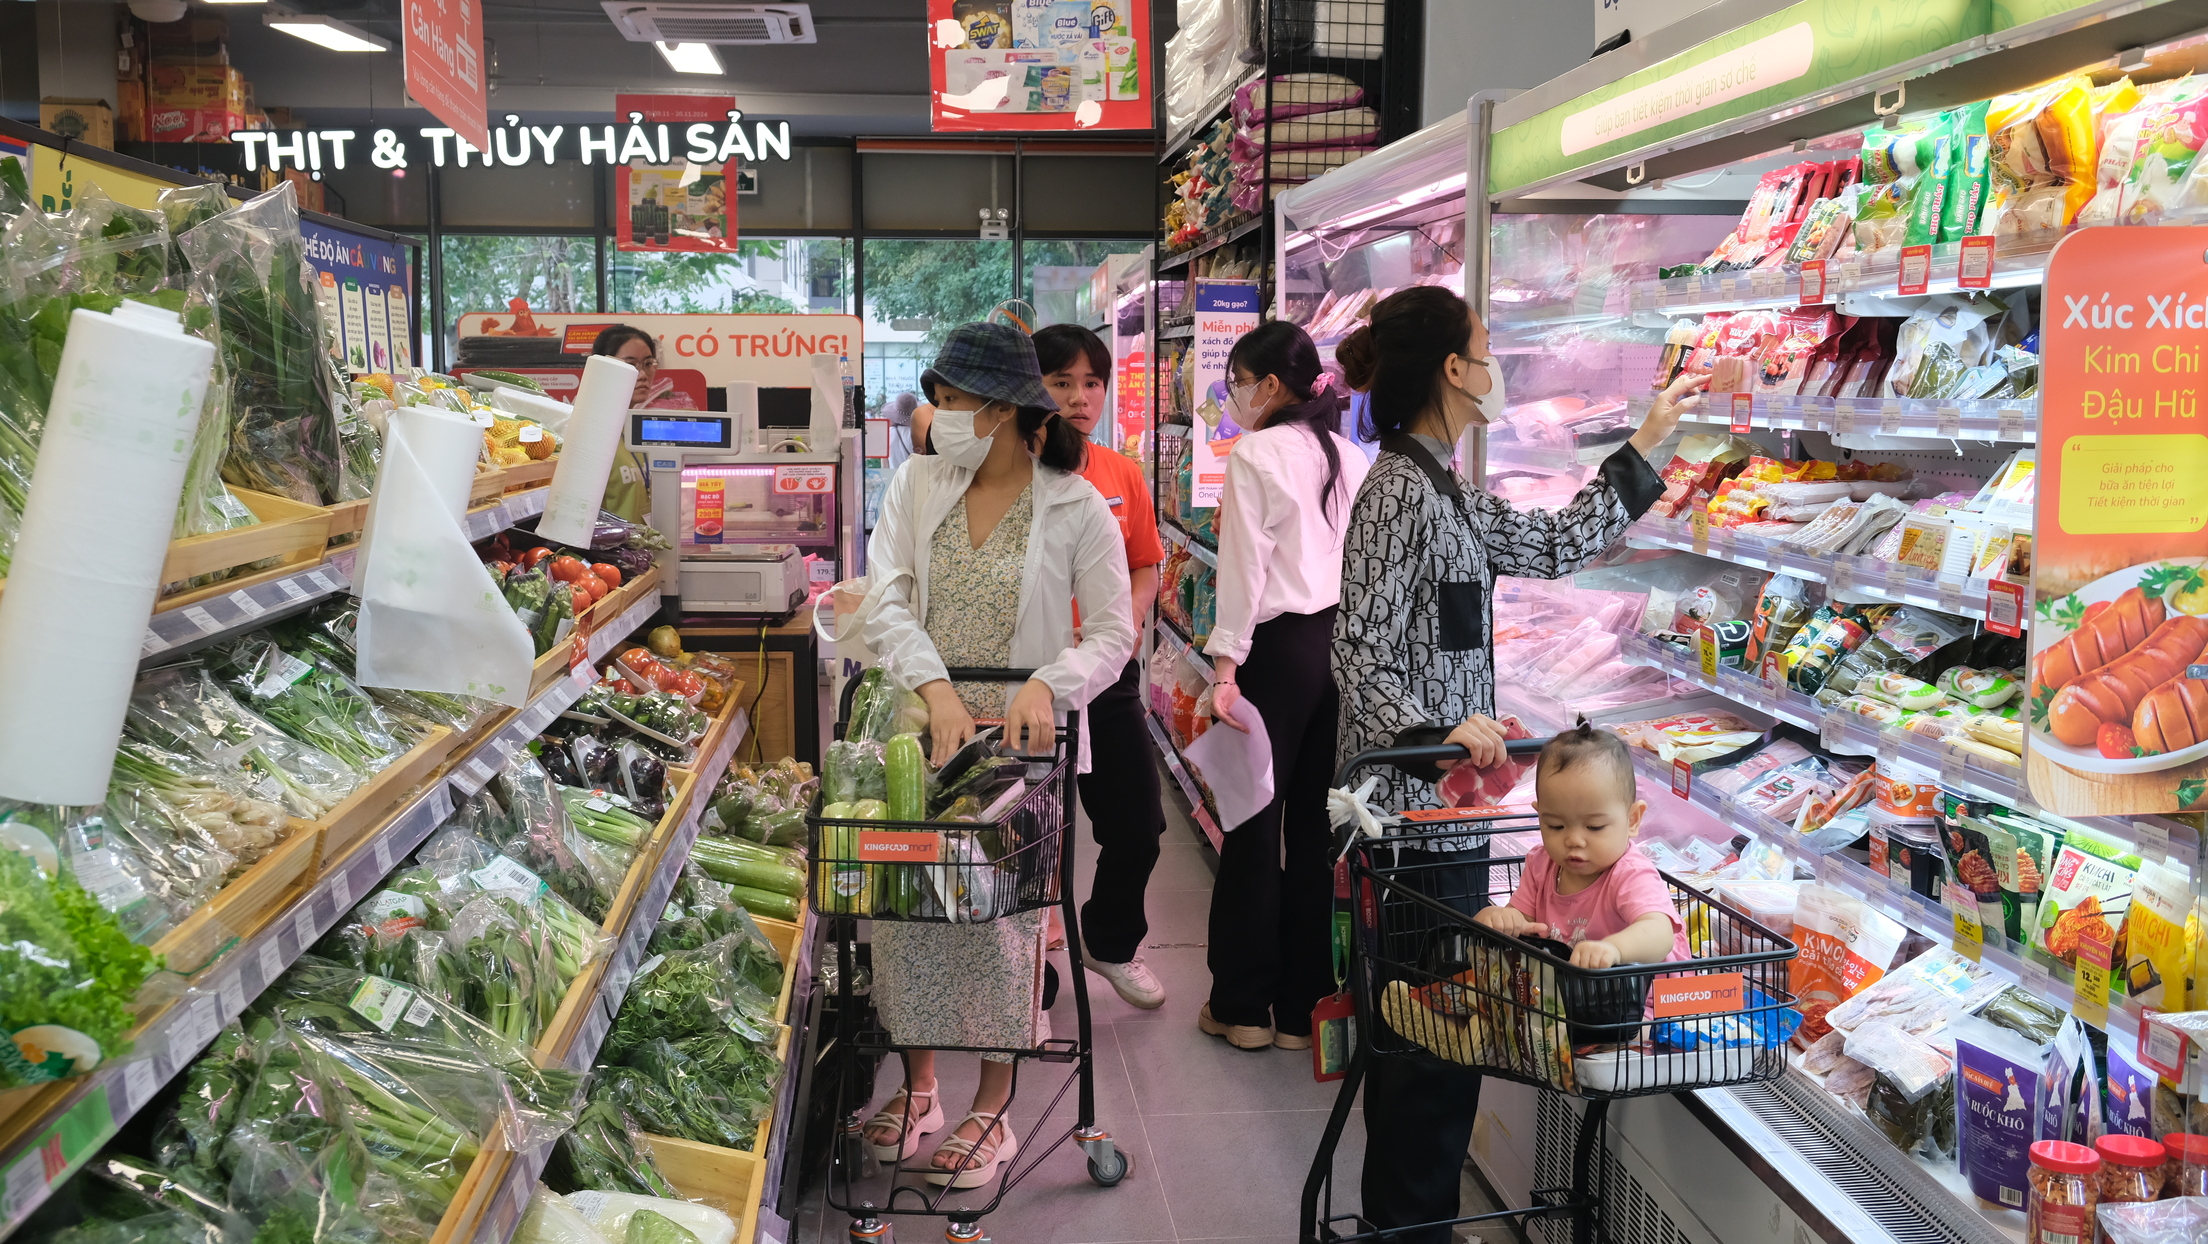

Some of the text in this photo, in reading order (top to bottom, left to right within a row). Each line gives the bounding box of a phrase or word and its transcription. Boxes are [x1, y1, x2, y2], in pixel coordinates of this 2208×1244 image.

[1057, 18, 1077, 27] Blue
[1093, 9, 1113, 27] Gift
[969, 24, 999, 39] SWAT
[431, 20, 455, 78] Hàng
[1594, 52, 1757, 137] Giúp bạn tiết kiệm thời gian sơ chế
[231, 110, 791, 181] THỊT & THỦY HẢI SẢN
[1929, 183, 1945, 236] THỌ PHÁT
[1964, 181, 1981, 234] THỌ PHÁT
[320, 238, 335, 266] ĐỘ
[336, 240, 350, 266] ĂN
[1212, 299, 1248, 310] 20kg gạo?
[2062, 291, 2134, 330] Xúc
[1202, 319, 1256, 335] Miễn phí
[675, 326, 849, 358] CÓ TRỨNG!
[1202, 336, 1221, 345] xách
[1201, 348, 1220, 358] giúp
[2084, 344, 2201, 374] Kim Chi
[2081, 388, 2197, 426] Đậu Hũ
[2101, 460, 2174, 477] Giải pháp cho
[2099, 478, 2175, 493] bữa ăn tiện lợi
[2087, 494, 2185, 510] Tiết kiệm thời gian
[864, 843, 932, 852] KINGFOODmart
[2149, 917, 2171, 948] CHI
[1800, 948, 1820, 962] Cải
[1660, 986, 1738, 1004] KINGFOODmart
[1970, 1098, 1996, 1121] RUỐC
[1997, 1112, 2025, 1131] KHÔ
[2044, 1108, 2058, 1128] KHÔ
